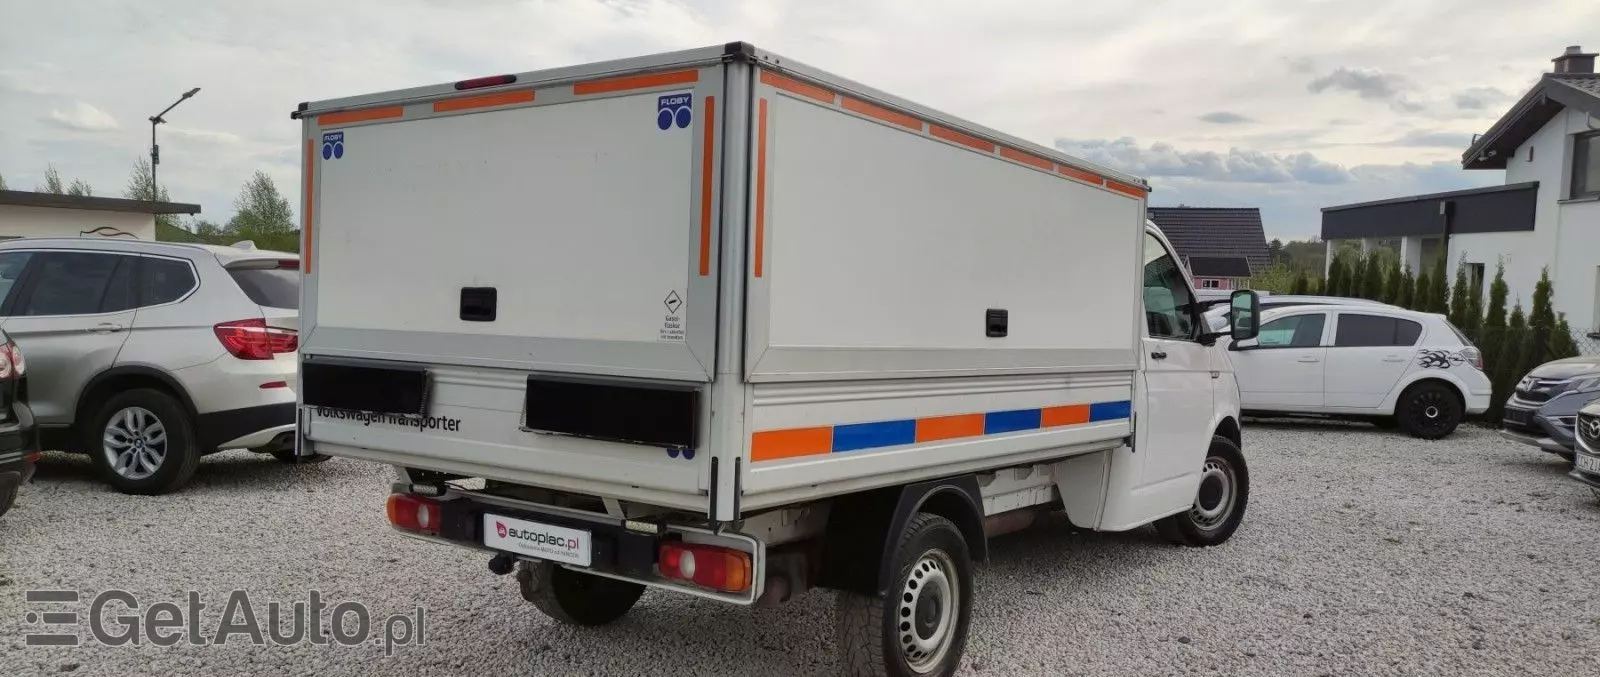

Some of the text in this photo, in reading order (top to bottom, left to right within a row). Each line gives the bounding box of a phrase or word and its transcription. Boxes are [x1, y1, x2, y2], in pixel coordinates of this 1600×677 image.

[660, 96, 689, 106] FLOBY
[317, 406, 385, 426] Volkswagen
[508, 527, 579, 551] autoplac.pl
